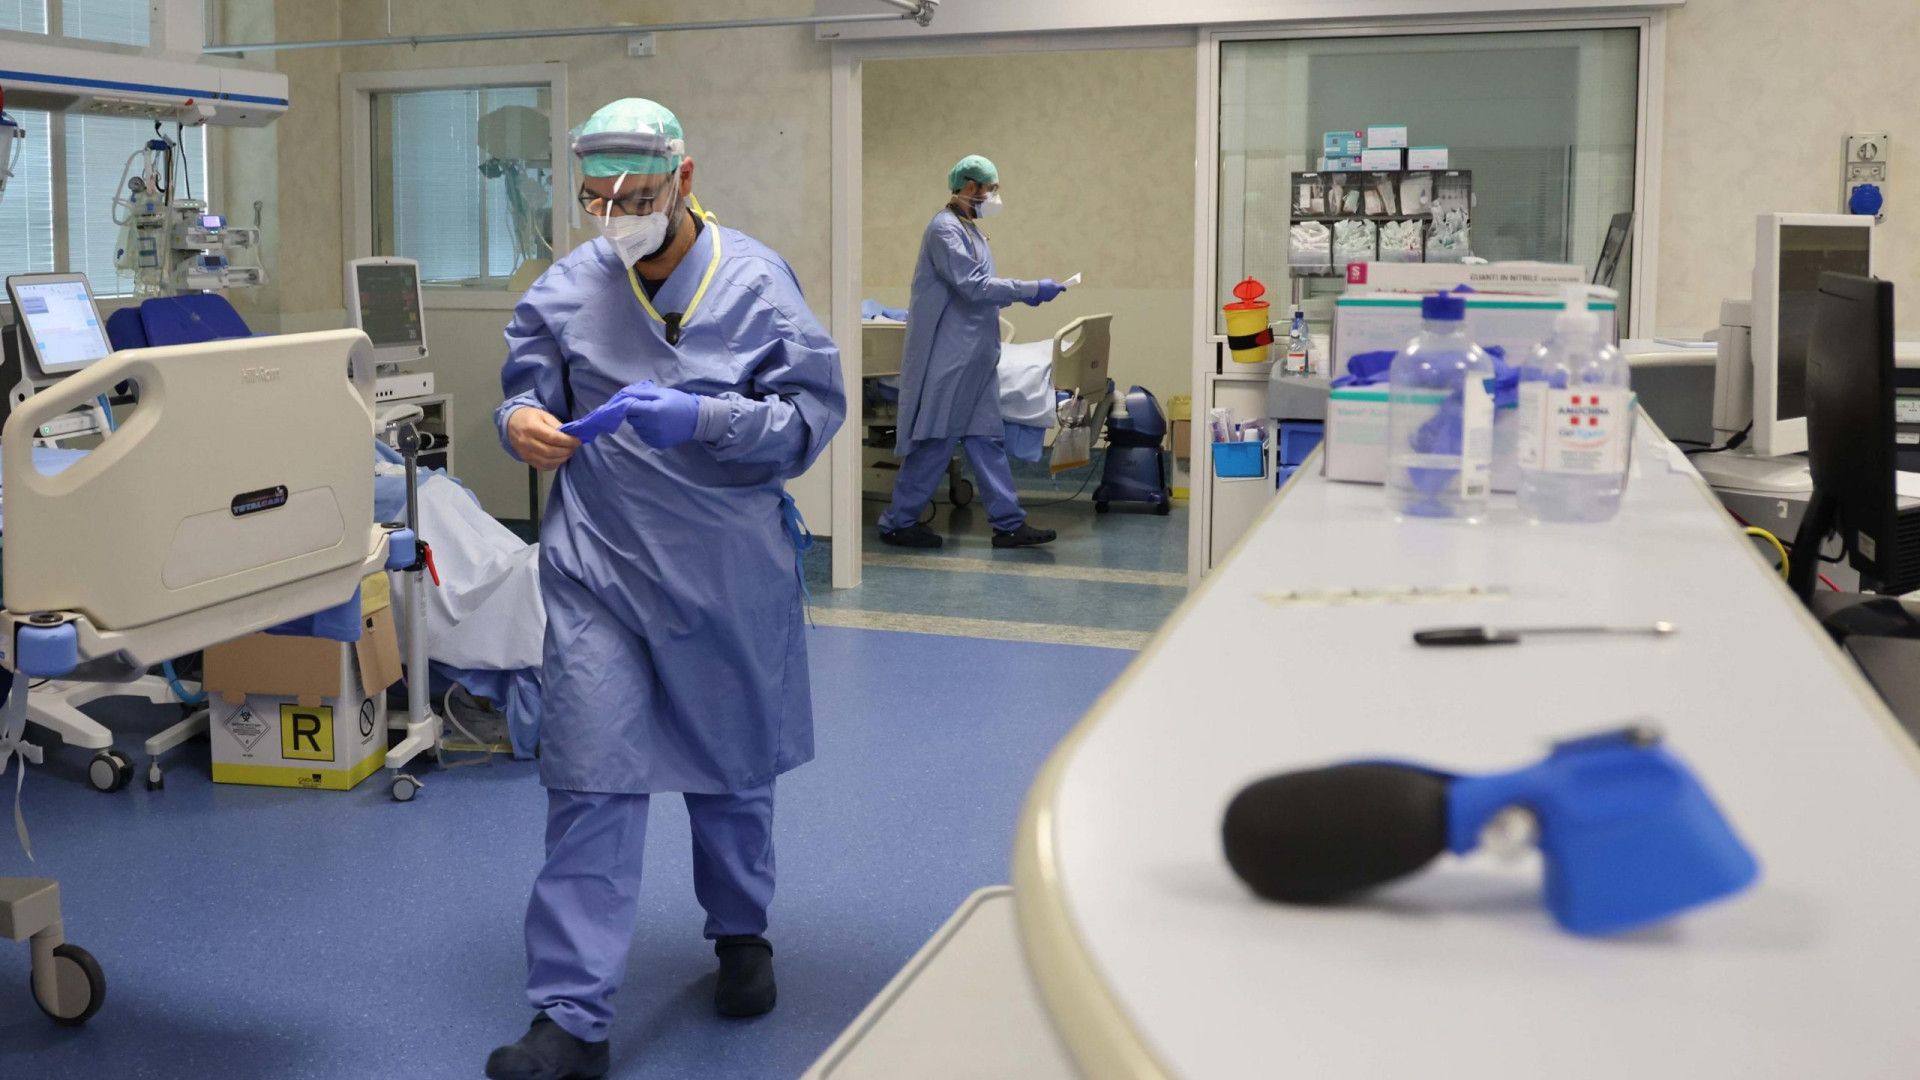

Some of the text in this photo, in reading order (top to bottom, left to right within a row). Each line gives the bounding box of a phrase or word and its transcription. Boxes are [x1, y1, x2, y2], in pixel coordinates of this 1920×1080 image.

[1352, 266, 1361, 277] S
[1470, 272, 1499, 281] GUANTI
[1500, 273, 1509, 281] IN
[1510, 273, 1538, 282] NITRILE
[1558, 406, 1610, 415] AMUCHINA
[232, 496, 286, 514] TOTALCARE
[292, 713, 322, 751] R
